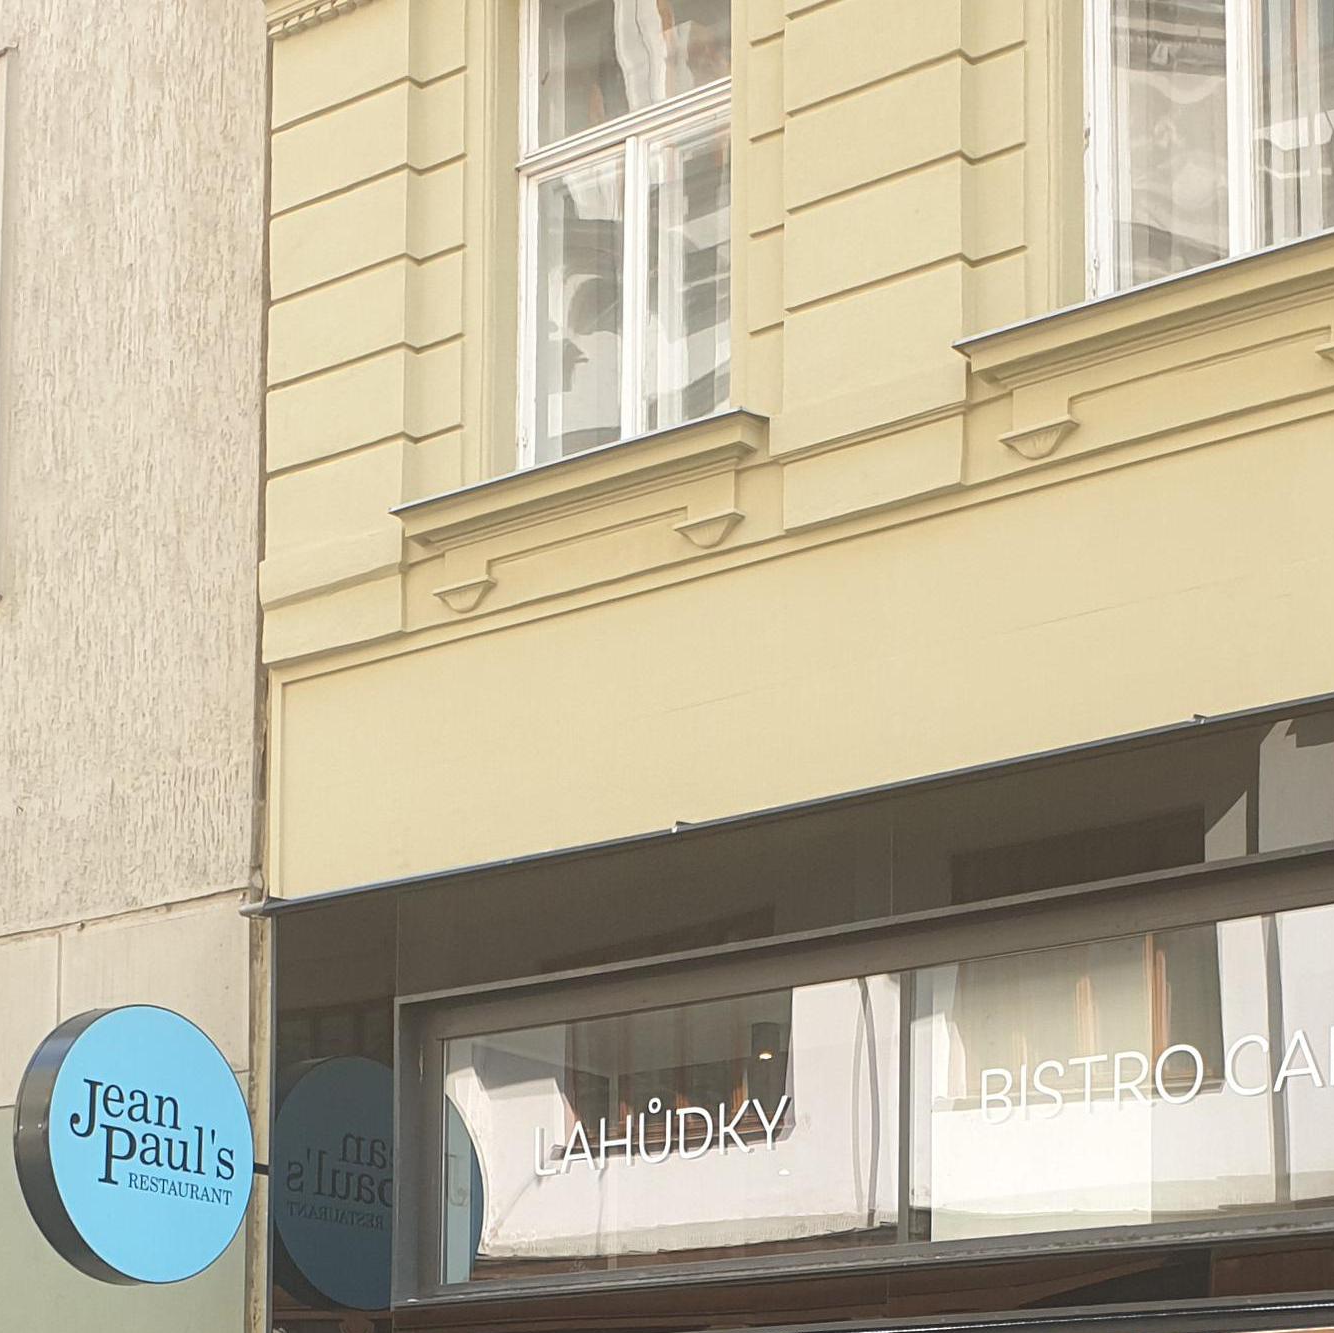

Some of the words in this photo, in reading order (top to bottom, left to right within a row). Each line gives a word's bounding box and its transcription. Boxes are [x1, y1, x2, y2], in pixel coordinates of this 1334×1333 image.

[70, 1078, 182, 1138] Jean
[979, 1043, 1205, 1124] BISTRO
[98, 1123, 235, 1185] Paul's
[534, 1095, 791, 1176] LAHŮDKY
[128, 1172, 233, 1206] RESTAURANT
